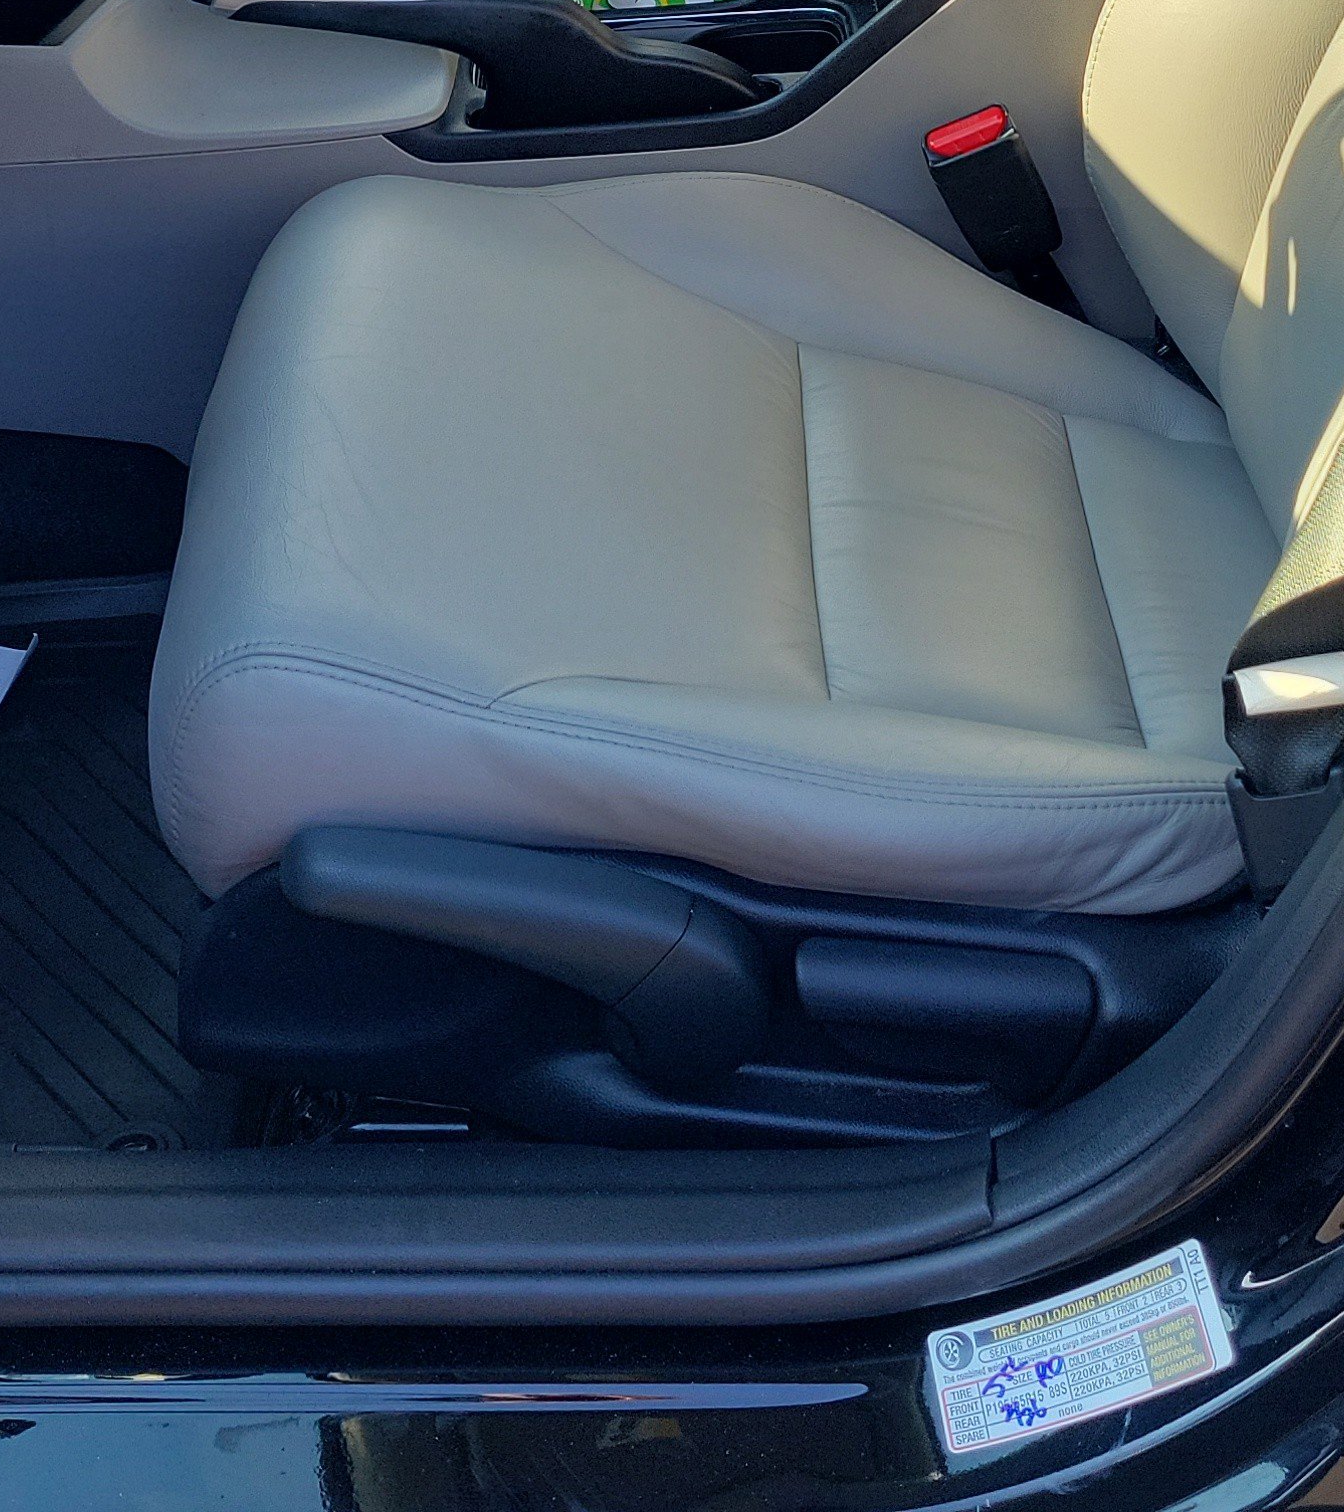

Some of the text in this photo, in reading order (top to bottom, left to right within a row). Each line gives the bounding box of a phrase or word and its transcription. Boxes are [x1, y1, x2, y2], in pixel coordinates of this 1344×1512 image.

[990, 1262, 1174, 1341] TIRE AND LOADING INFORMATION
[950, 1385, 973, 1401] TIRE
[1011, 1370, 1033, 1385] SIZE
[1067, 1353, 1086, 1367] COLD
[1101, 1334, 1136, 1356] PRESSURE
[989, 1340, 1022, 1360] SEATING
[1025, 1326, 1064, 1348] CAPACITY
[949, 1398, 979, 1418] FRONT
[1112, 1349, 1141, 1367] 32PSI
[954, 1414, 980, 1432] REAR
[1115, 1363, 1145, 1382] 32PSI
[955, 1427, 985, 1447] SPARE
[1058, 1402, 1083, 1417] none
